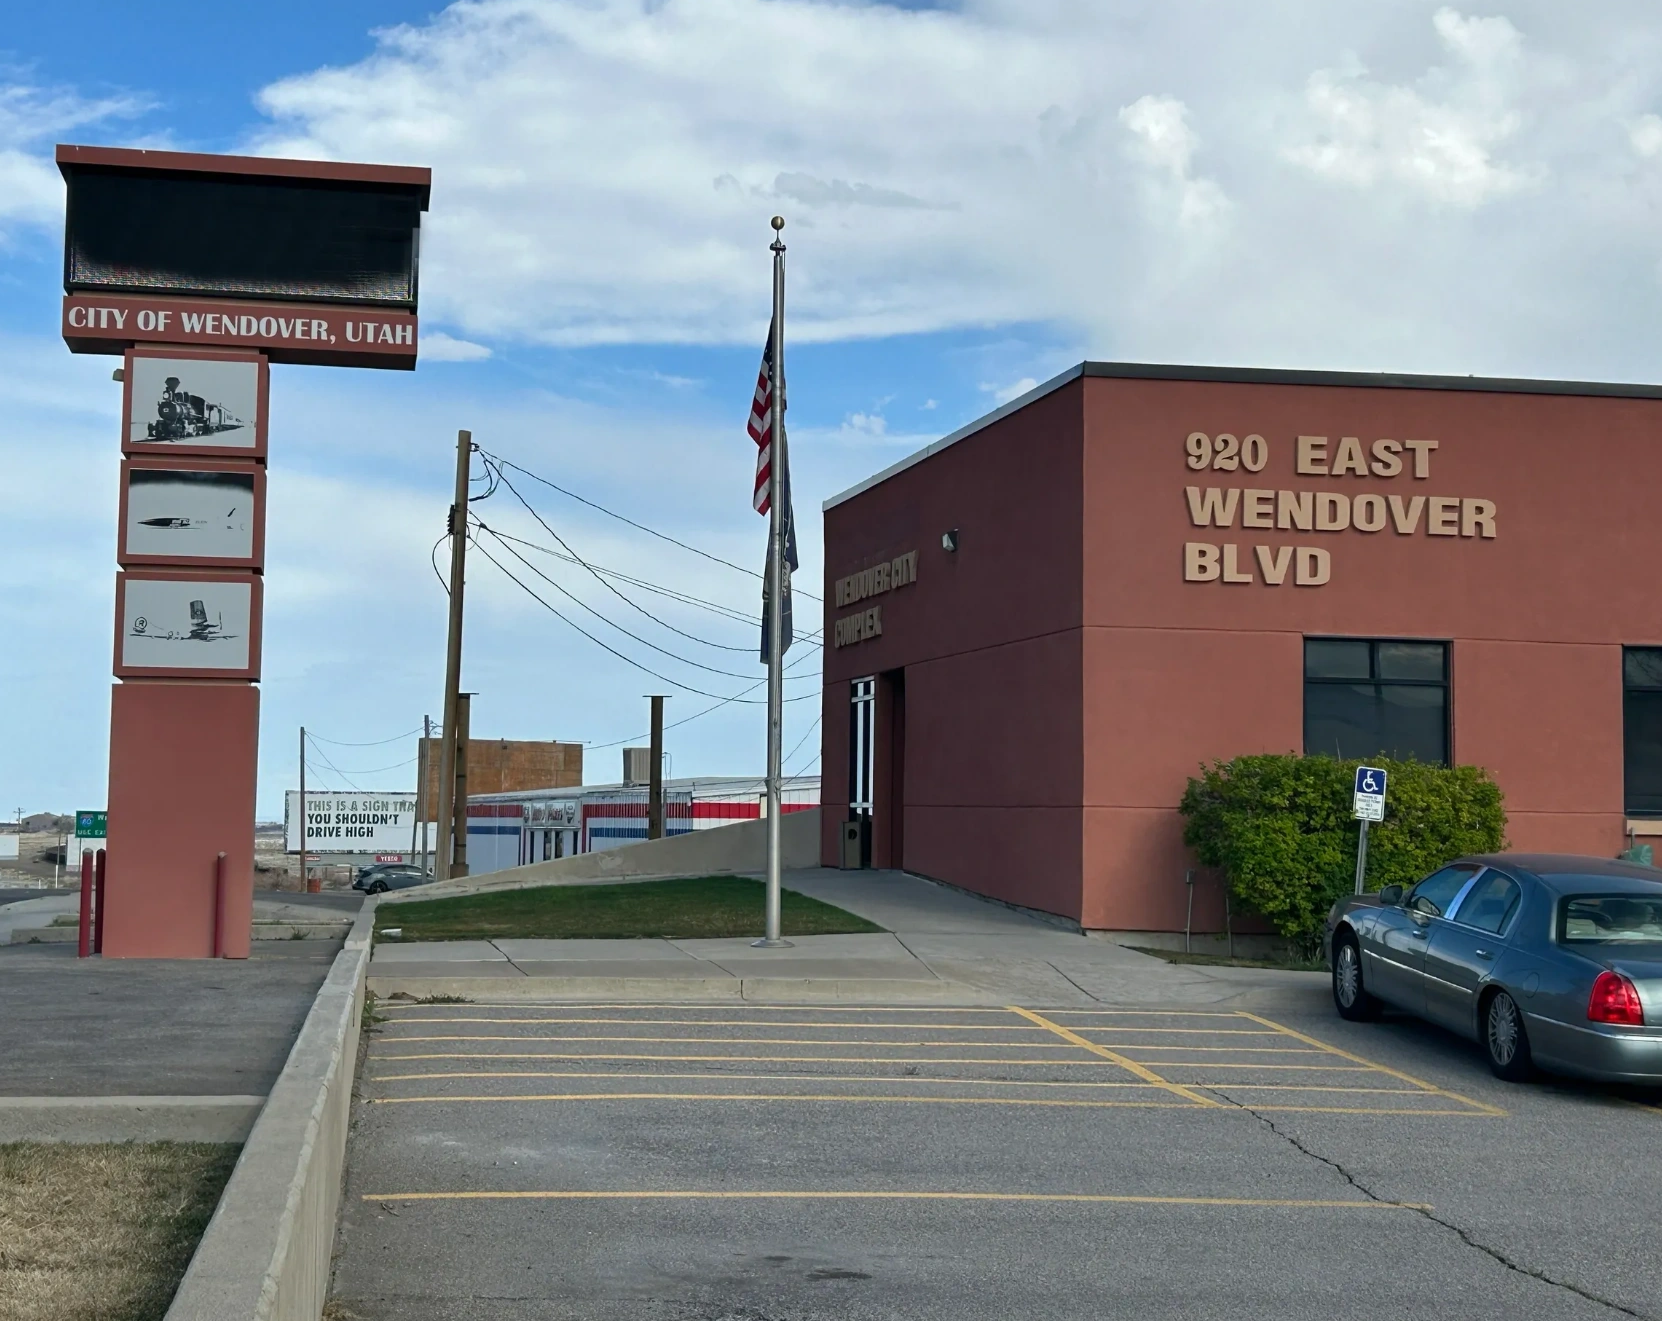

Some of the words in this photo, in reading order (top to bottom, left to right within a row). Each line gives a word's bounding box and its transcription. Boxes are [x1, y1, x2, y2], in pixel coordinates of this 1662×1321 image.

[68, 306, 128, 330] CITY
[137, 309, 172, 332] OF
[181, 312, 336, 344] WENDOVER,
[345, 320, 413, 345] UTAH
[1186, 431, 1269, 472] 920
[1296, 435, 1439, 479] EAST
[1185, 486, 1497, 539] WENDOVER
[835, 562, 891, 608] WENDOVER
[891, 549, 919, 589] CITY
[1184, 542, 1332, 586] BLVD
[834, 605, 883, 649] COMPLEX
[307, 800, 332, 812] THIS
[336, 800, 346, 812] IS
[350, 800, 358, 812] A
[362, 800, 389, 812] SIGN
[394, 801, 416, 813] THA
[307, 813, 331, 825] YOU
[335, 813, 399, 825] SHOULDN'T
[307, 826, 342, 838] DRIVE
[345, 826, 374, 838] HIGH
